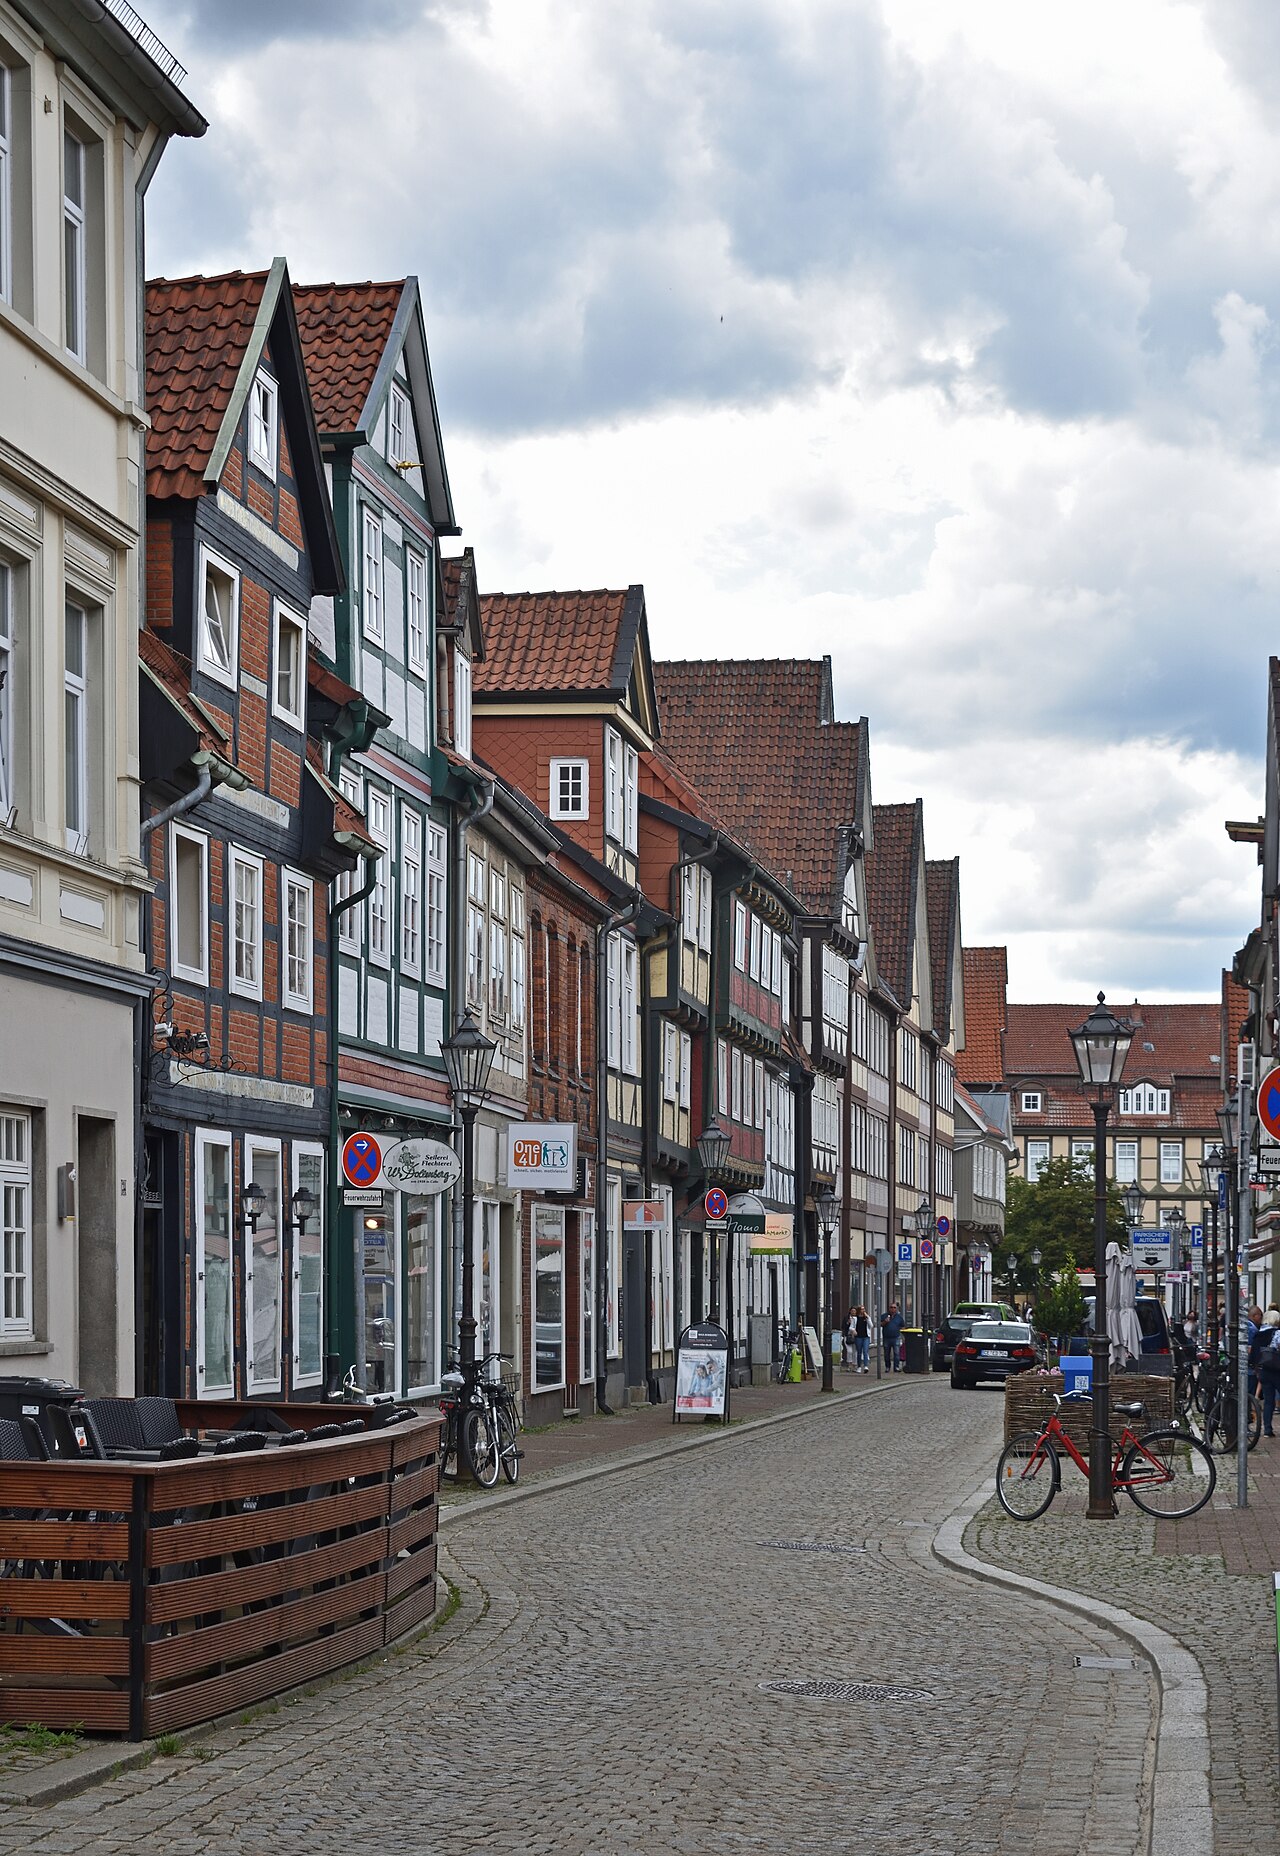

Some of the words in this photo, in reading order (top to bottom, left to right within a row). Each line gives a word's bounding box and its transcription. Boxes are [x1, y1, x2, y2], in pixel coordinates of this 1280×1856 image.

[515, 1141, 540, 1153] One
[519, 1153, 537, 1166] 4U
[1194, 1227, 1203, 1245] P
[901, 1246, 909, 1259] P
